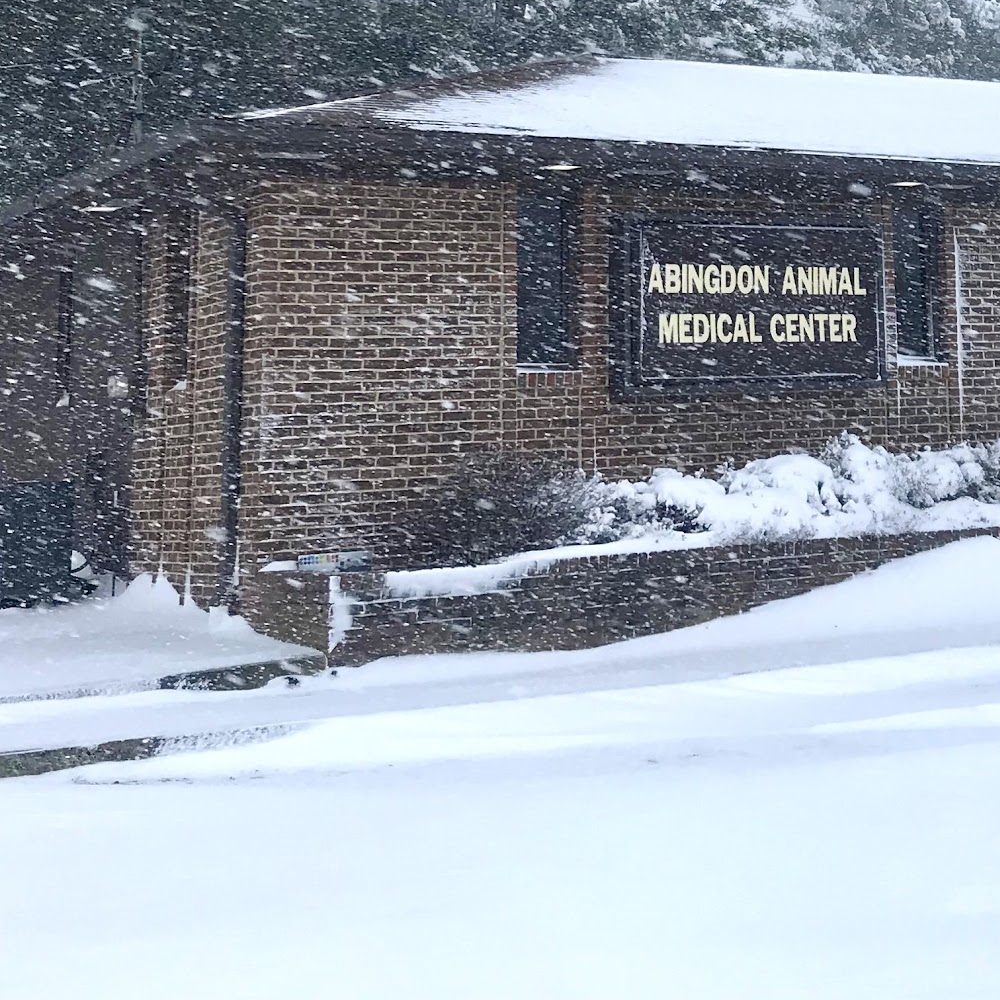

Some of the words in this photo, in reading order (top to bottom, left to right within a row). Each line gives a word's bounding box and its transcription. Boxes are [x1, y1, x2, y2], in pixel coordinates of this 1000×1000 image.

[648, 264, 769, 295] ABINGDON
[782, 266, 867, 296] ANIMAL
[658, 313, 762, 344] MEDICAL
[769, 313, 858, 343] CENTER
